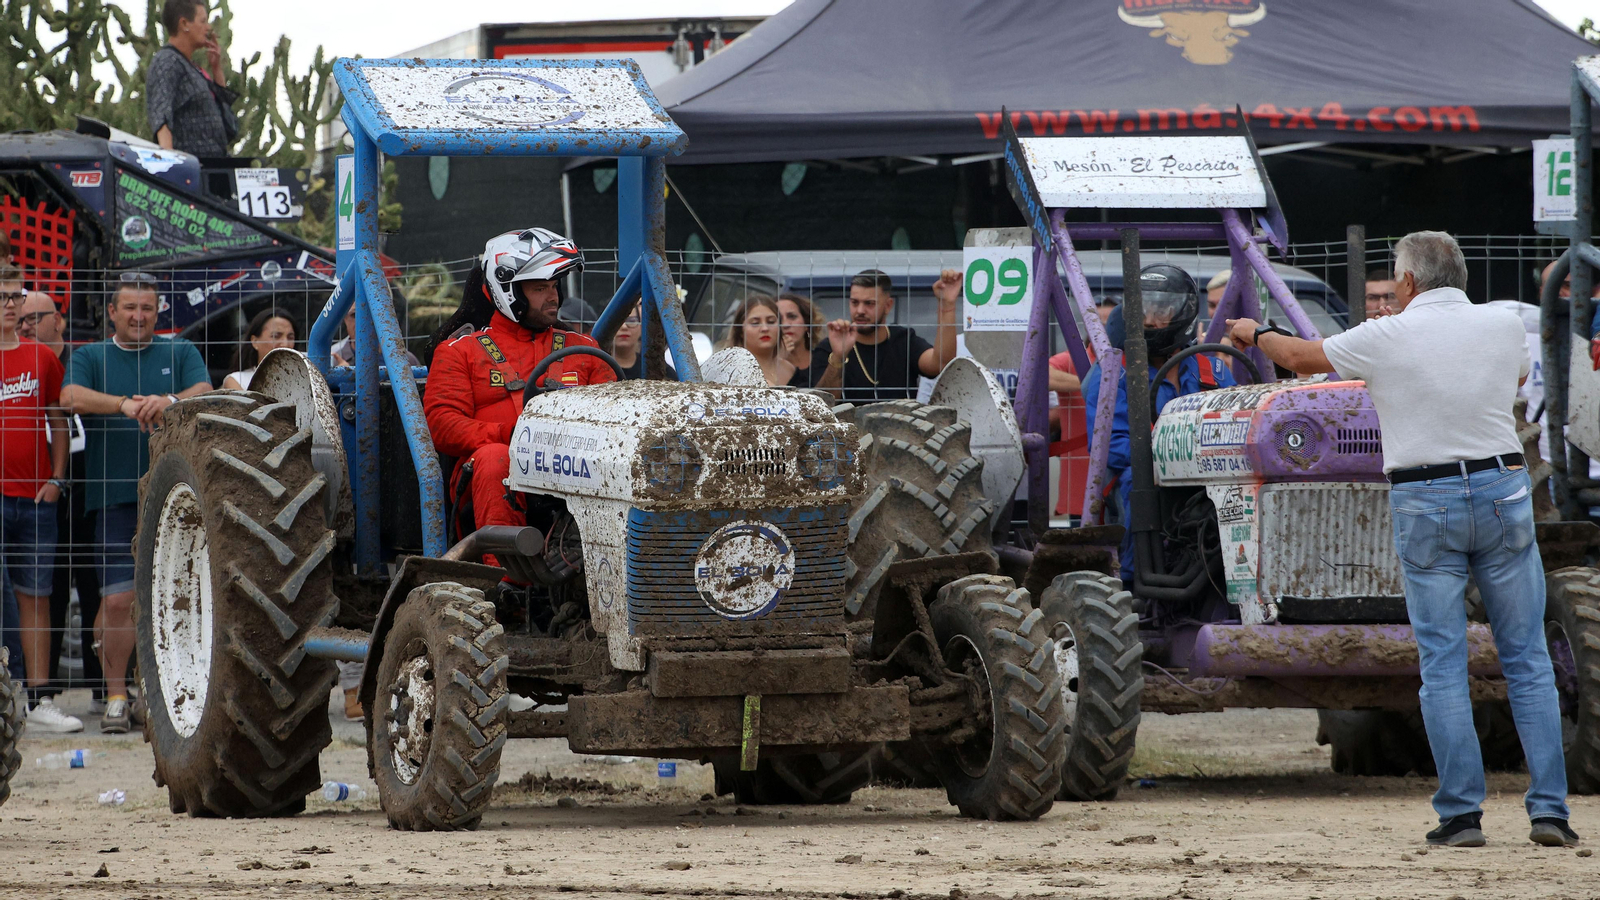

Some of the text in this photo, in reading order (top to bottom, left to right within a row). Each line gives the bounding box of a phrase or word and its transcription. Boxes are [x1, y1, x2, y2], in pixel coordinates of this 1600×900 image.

[1545, 151, 1571, 196] 12
[149, 190, 172, 208] OFF
[171, 200, 207, 226] ROAD
[241, 191, 290, 216] 113
[340, 170, 354, 222] 4
[124, 192, 206, 238] 622 39 90 02
[965, 258, 1028, 305] 09
[0, 371, 39, 396] rooklyn
[535, 450, 591, 478] EL BOLA
[1202, 458, 1212, 471] 95
[1213, 458, 1226, 471] 587
